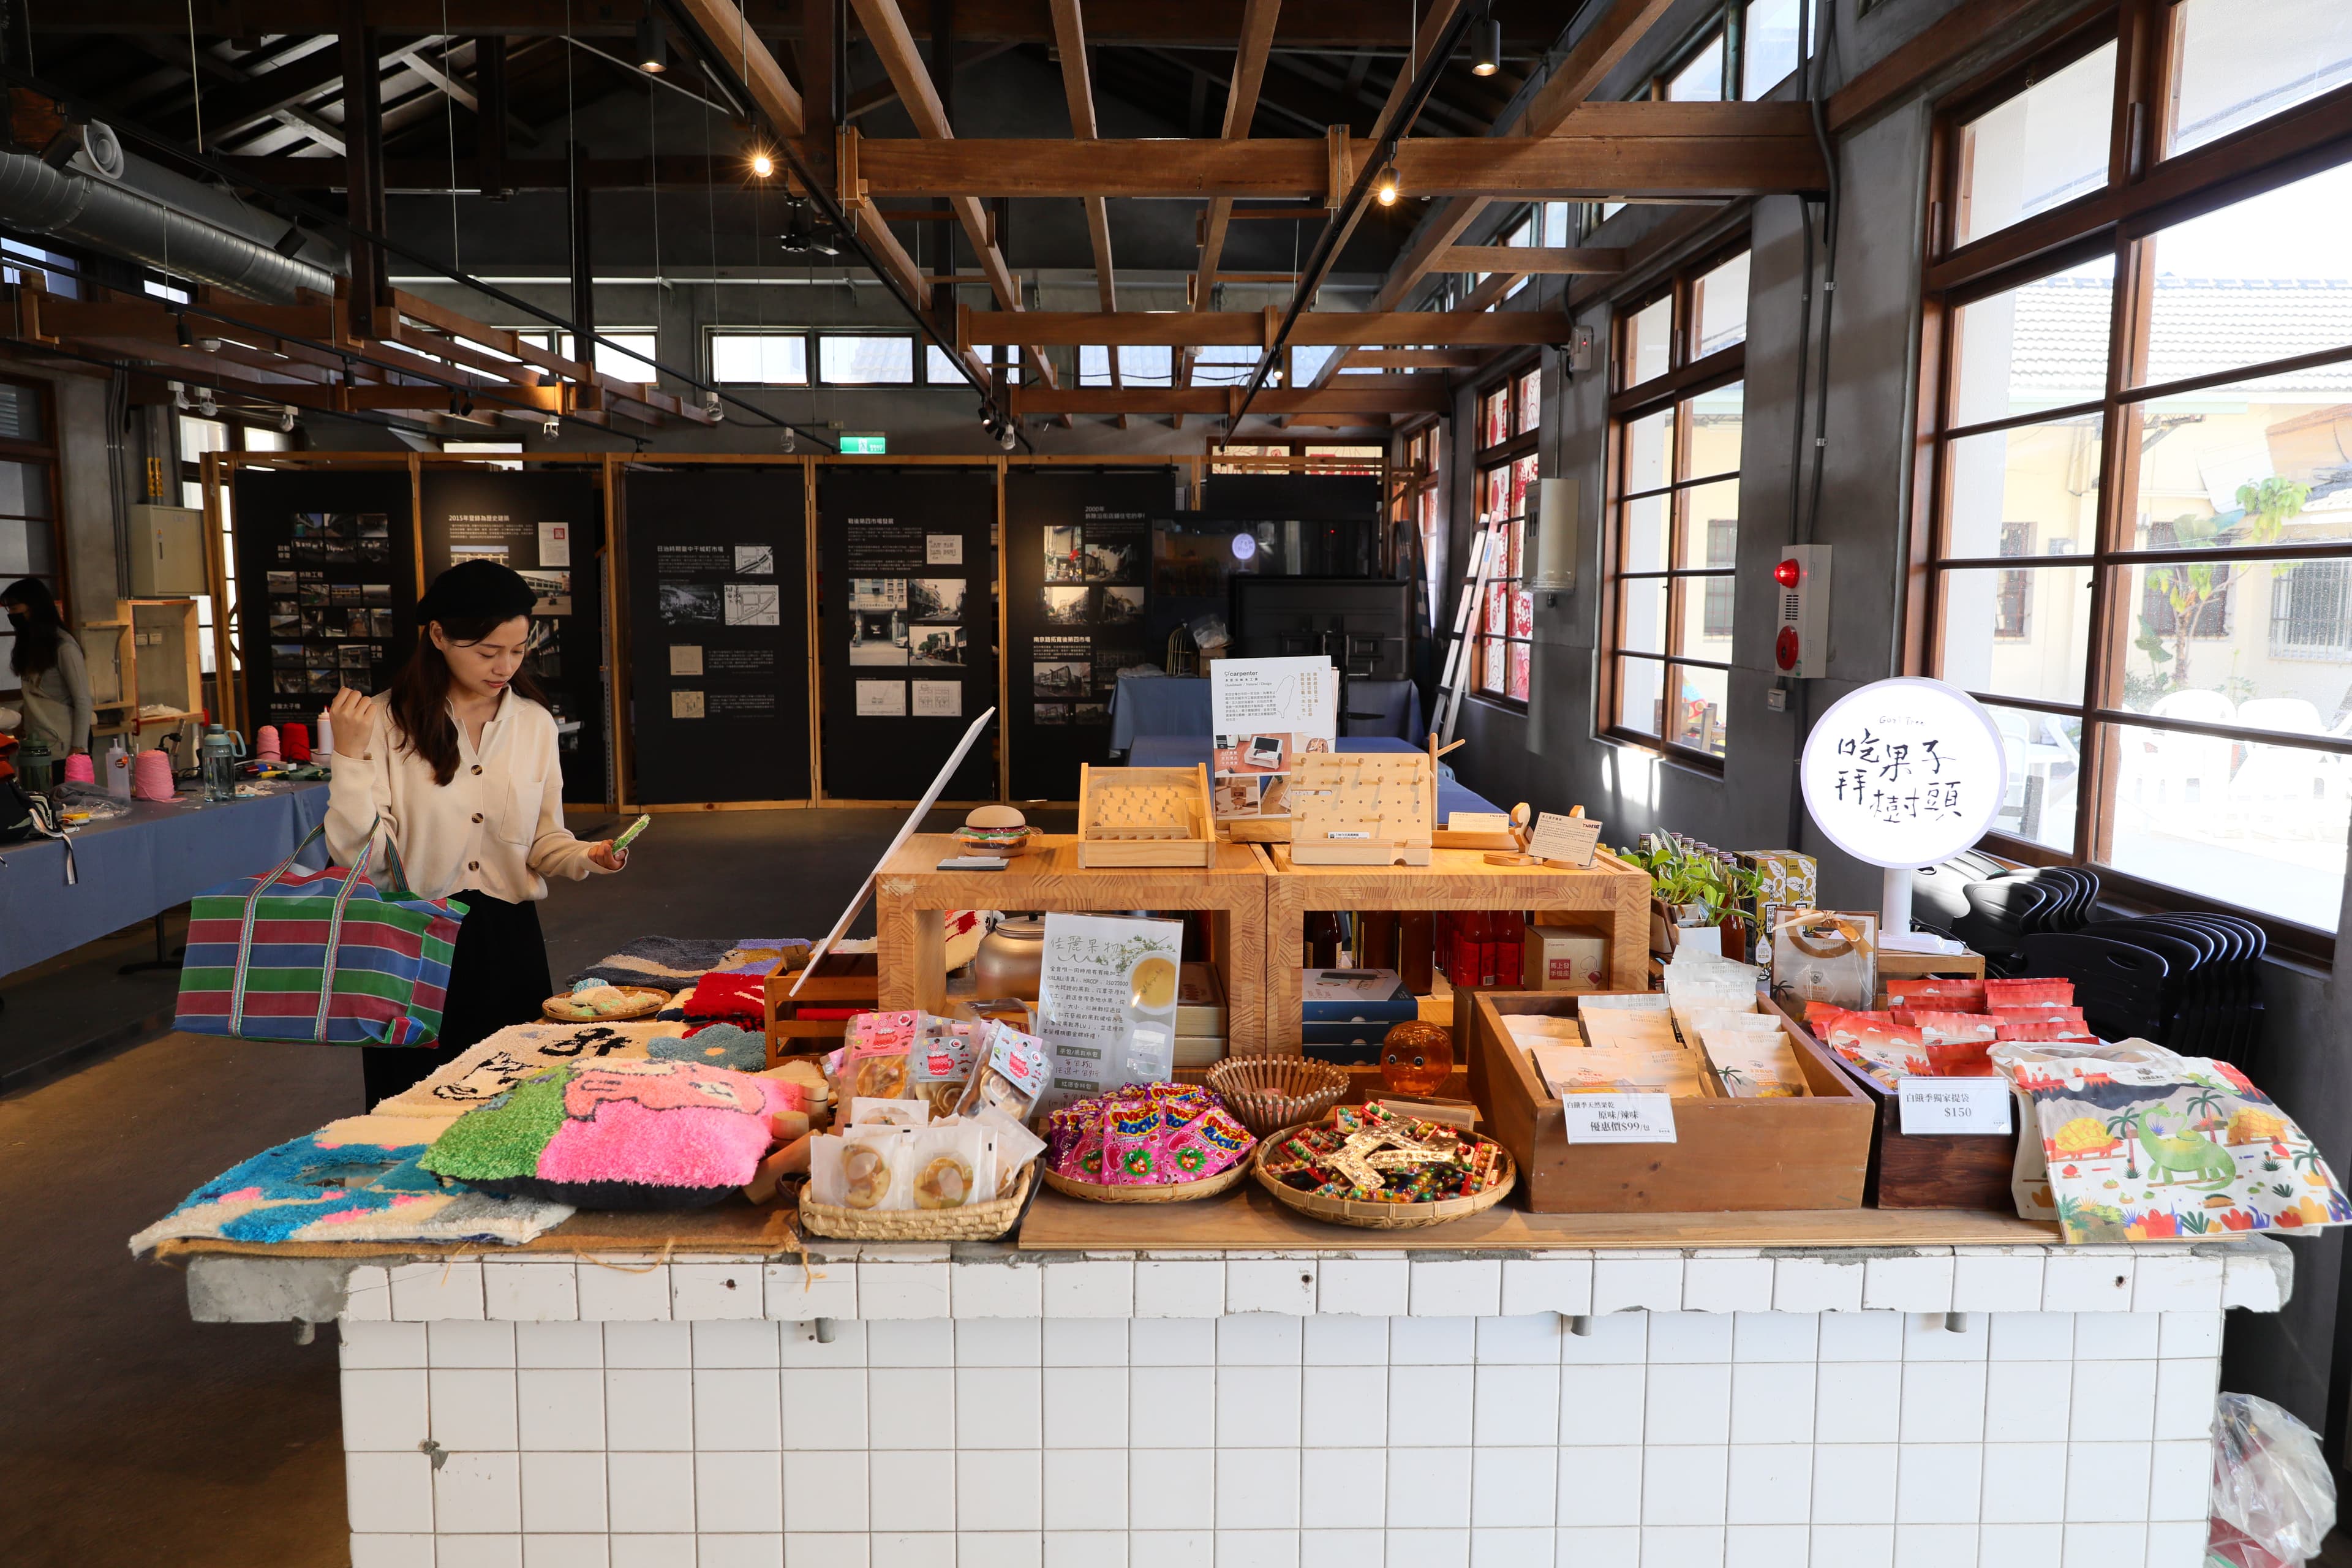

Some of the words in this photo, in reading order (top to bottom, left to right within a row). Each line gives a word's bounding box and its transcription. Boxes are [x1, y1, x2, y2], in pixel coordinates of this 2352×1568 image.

[1838, 728, 1956, 782] 吃果子
[1835, 769, 1961, 823] 拜樹頭
[1050, 935, 1119, 954] 佳麗果物
[1598, 1110, 1638, 1120] 原味/辣味
[1944, 1107, 1972, 1117] $150
[1117, 1112, 1159, 1135] ROCKS
[1591, 1121, 1650, 1132] 優惠價$99/包
